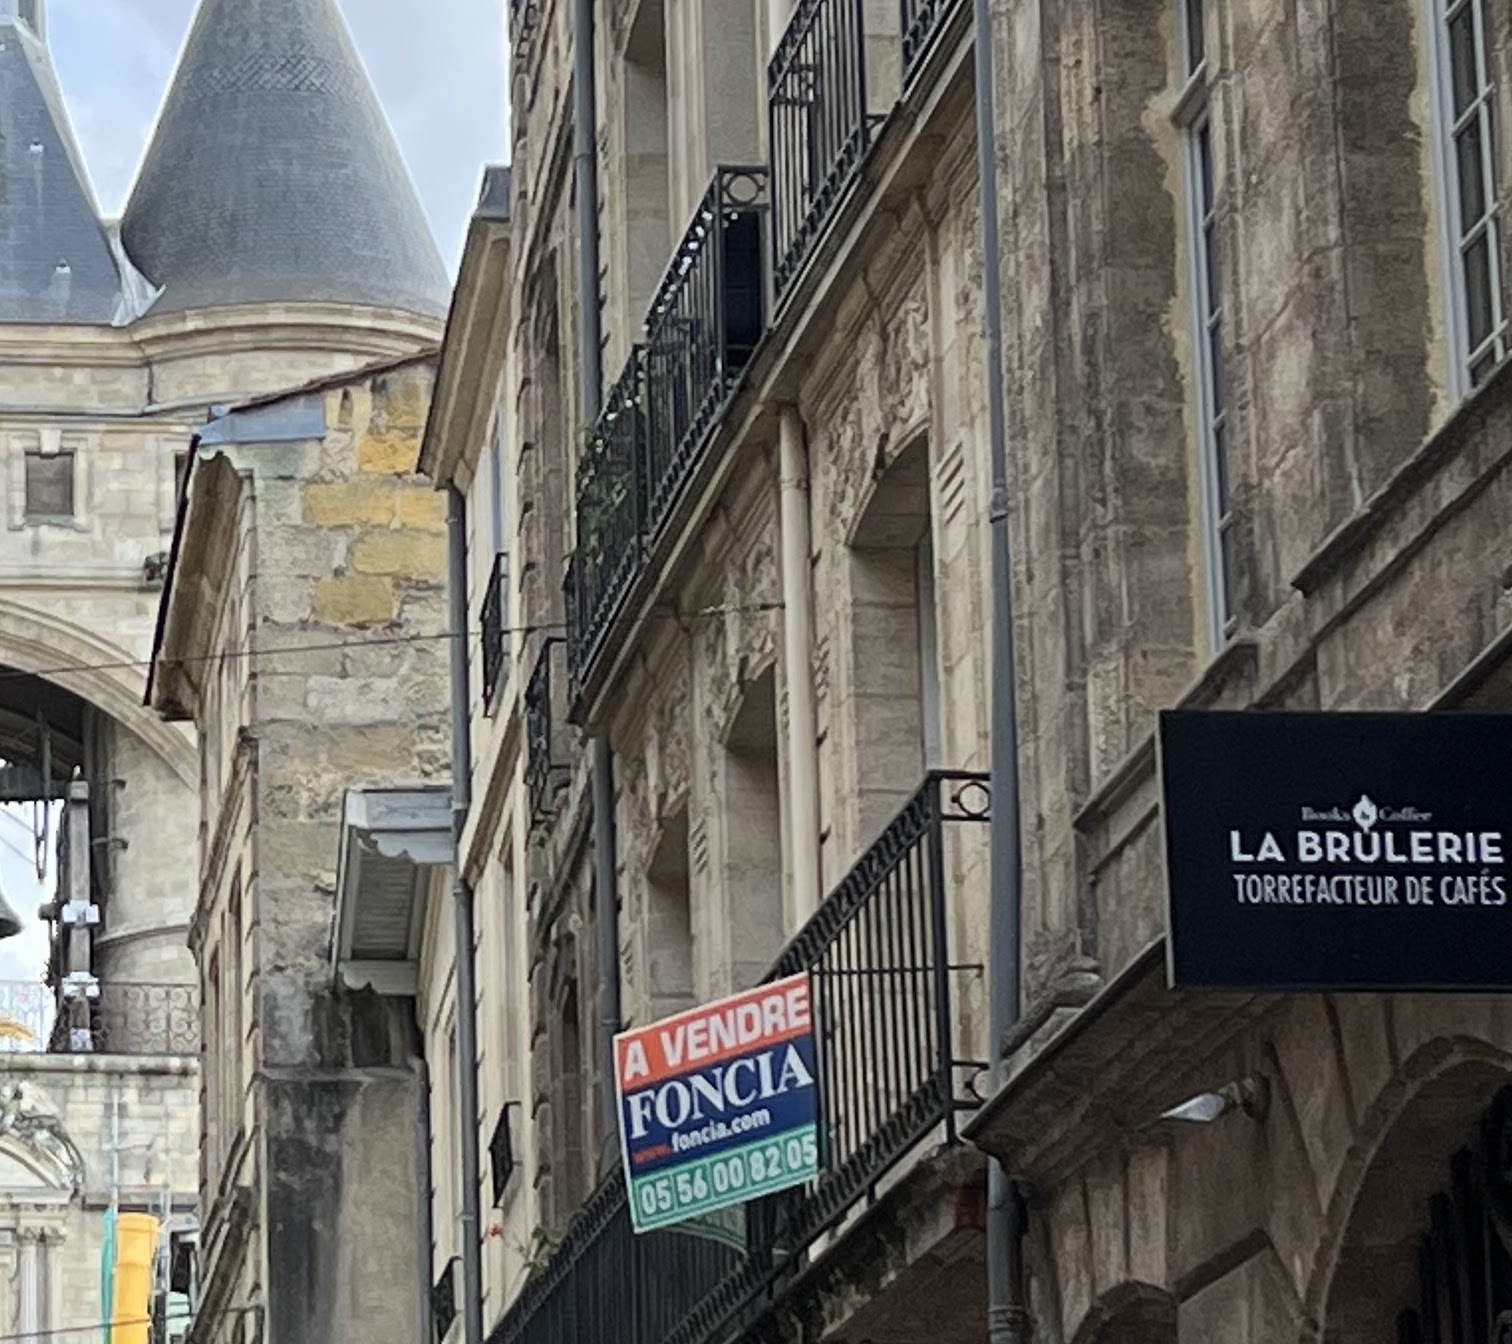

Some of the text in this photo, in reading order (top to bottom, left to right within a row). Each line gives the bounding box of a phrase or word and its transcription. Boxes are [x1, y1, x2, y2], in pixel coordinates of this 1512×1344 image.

[1230, 830, 1286, 862] LA
[1233, 867, 1506, 905] TORREFACTEUR DE CAFÉS
[623, 983, 812, 1084] A VENDRE
[627, 1043, 815, 1140] FONCIA
[640, 1133, 818, 1215] 05 56 00 82 05
